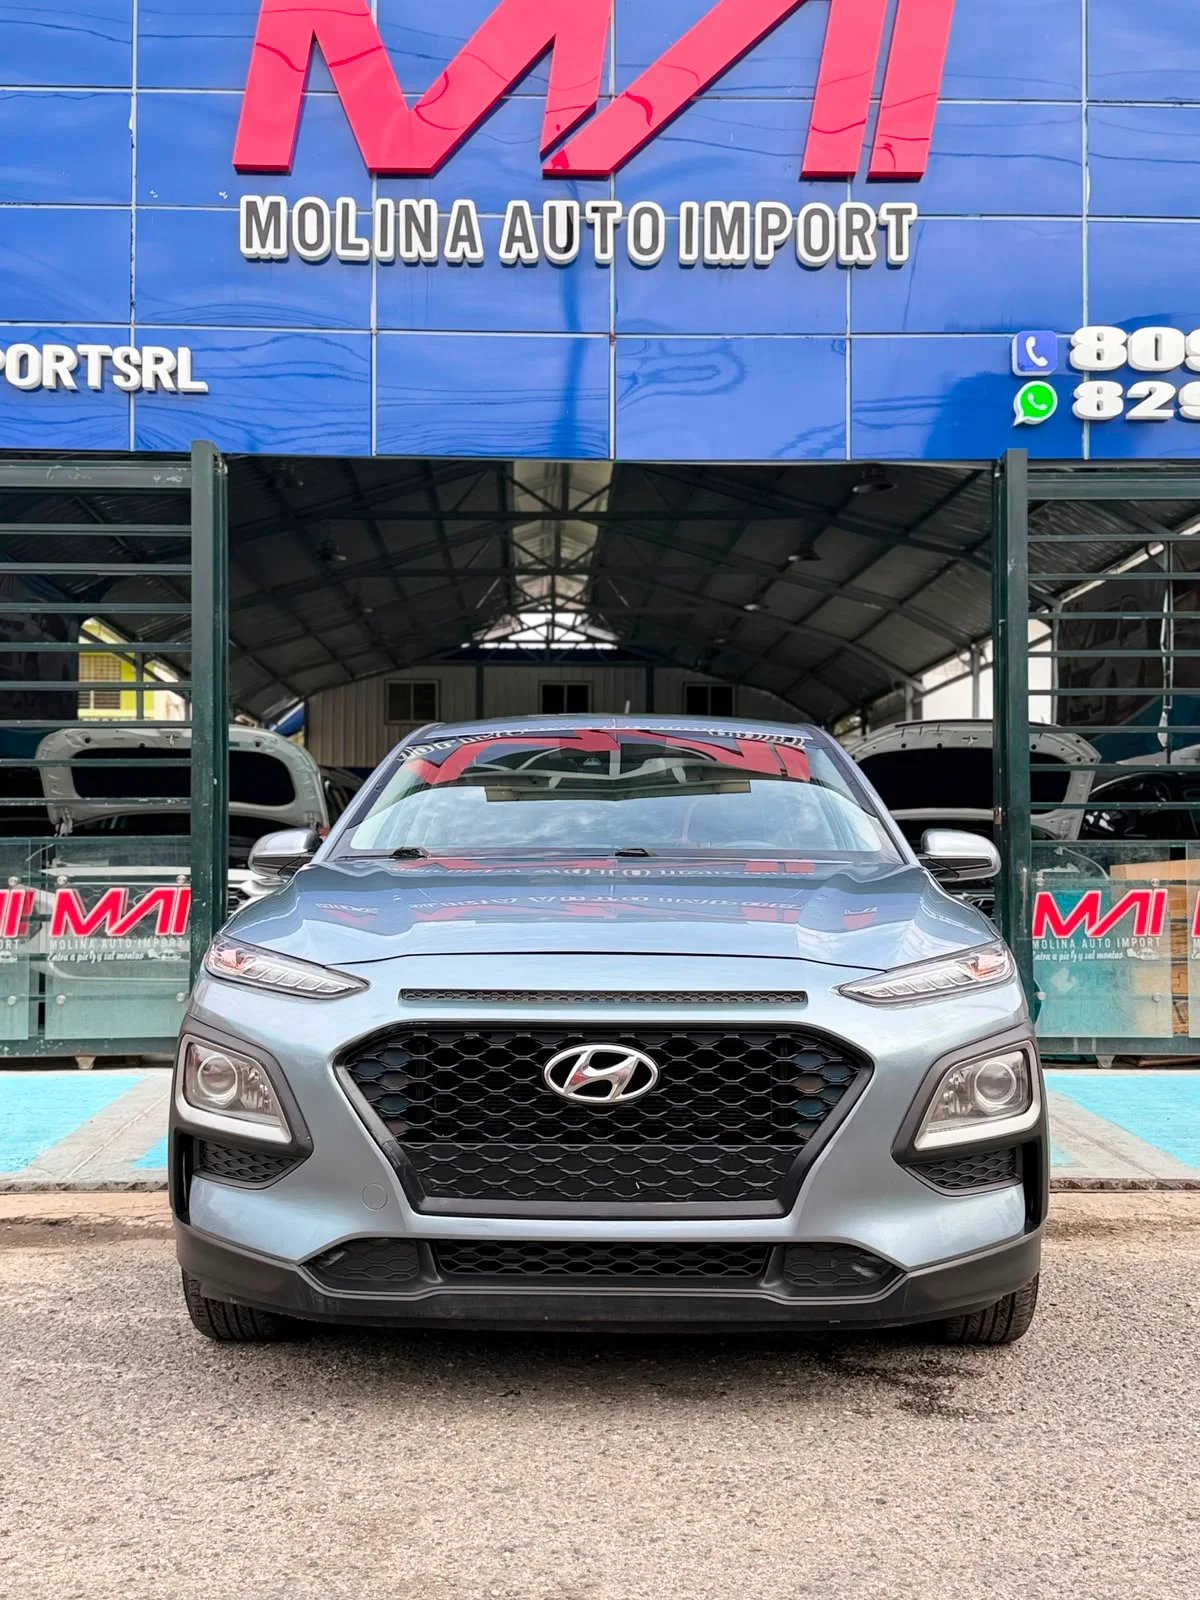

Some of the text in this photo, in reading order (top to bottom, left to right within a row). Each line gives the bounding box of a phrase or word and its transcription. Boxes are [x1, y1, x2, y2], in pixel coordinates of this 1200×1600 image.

[239, 195, 918, 267] MOLINA AUTO IMPORT
[0, 344, 208, 393] ORTSRL
[1032, 889, 1168, 939] MAI
[50, 937, 184, 950] MOLINA AUTO IMPORT
[1033, 937, 1160, 950] MOLINA AUTO IMPORT
